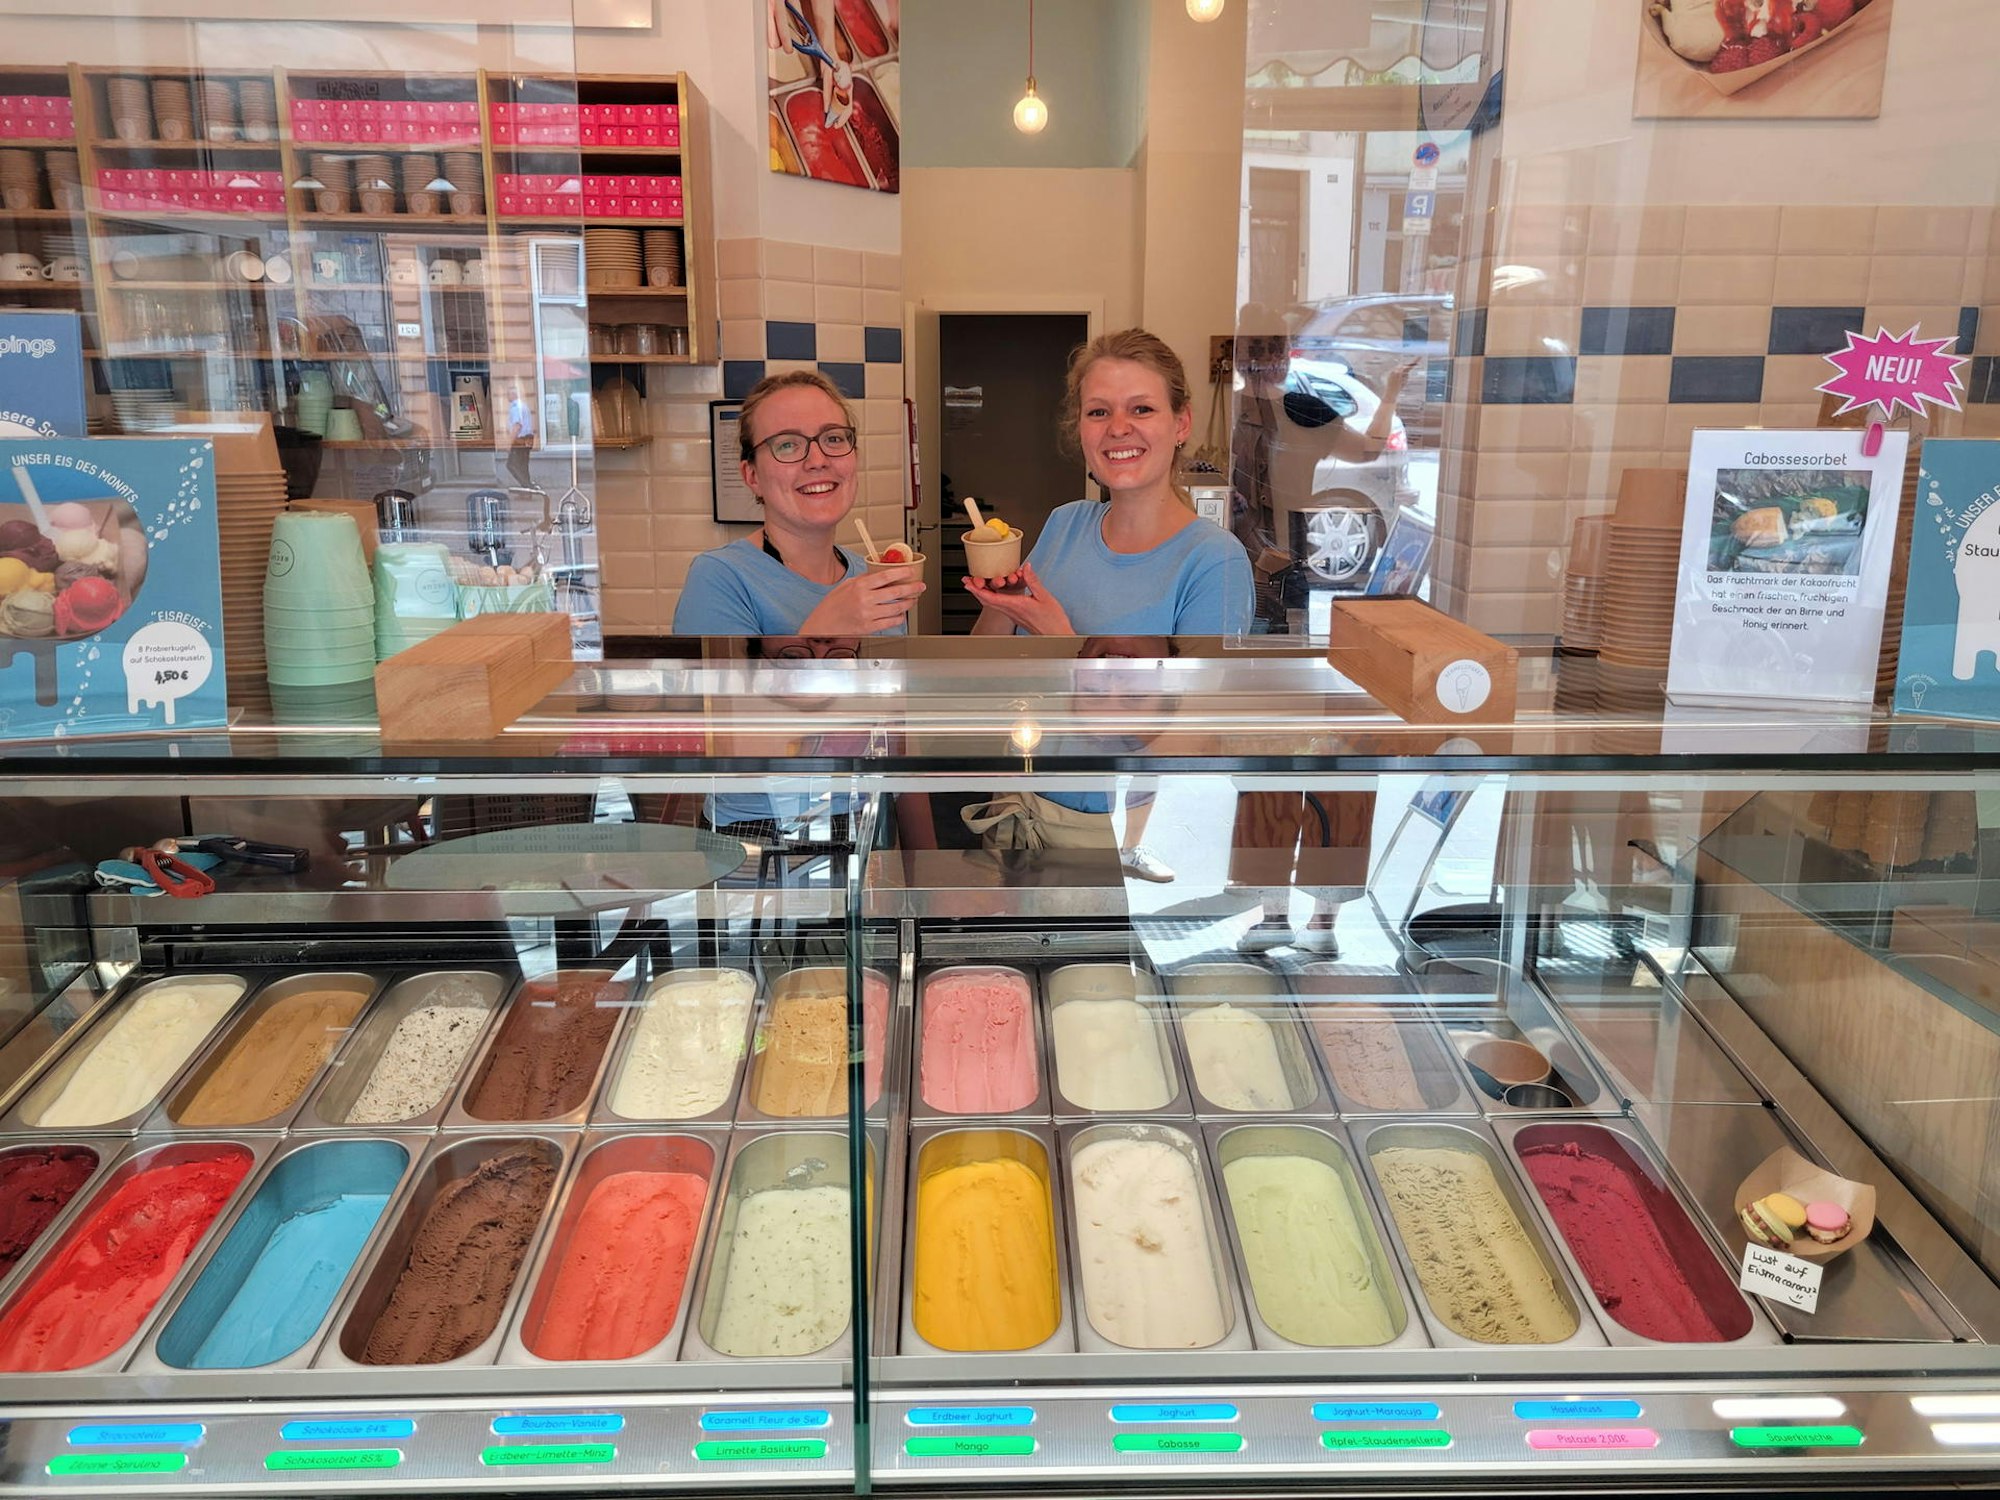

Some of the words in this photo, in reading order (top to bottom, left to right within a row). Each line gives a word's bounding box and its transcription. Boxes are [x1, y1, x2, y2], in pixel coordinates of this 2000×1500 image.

[1865, 355, 1922, 384] NEU!
[0, 410, 35, 427] sere
[11, 453, 51, 467] UNSER
[55, 455, 73, 468] EIS
[75, 459, 97, 475] DES
[1744, 452, 1847, 466] Cabossesorbet
[1955, 492, 1995, 528] UNSER
[1707, 575, 1723, 584] Das
[1726, 575, 1779, 586] Fruchtmark
[1782, 577, 1797, 586] der
[1800, 577, 1857, 588] Kakaofrucht
[1711, 590, 1727, 599] hat
[1757, 591, 1798, 602] frischen,
[1800, 593, 1849, 604] fruchtigen
[1712, 603, 1764, 614] Geschmack
[1767, 606, 1782, 615] der
[1785, 608, 1797, 616] an
[1800, 607, 1824, 616] Birne
[1826, 608, 1845, 617] und
[1742, 619, 1768, 630] Honig
[1771, 621, 1809, 631] erinnert.
[145, 644, 196, 653] Probierkugeln
[1753, 1250, 1778, 1266] Lust
[1784, 1263, 1809, 1279] auf
[1158, 1408, 1196, 1419] Joghurt
[1333, 1407, 1422, 1417] Joghurt-Maracuja
[1551, 1405, 1603, 1414] Haselnuss
[708, 1415, 755, 1425] Karamell
[758, 1415, 785, 1425] Fleur
[787, 1415, 801, 1424] de
[803, 1415, 820, 1424] Sel
[932, 1411, 970, 1421] Erdbeer
[974, 1411, 1013, 1423] Joghurt
[302, 1425, 363, 1435] Schokolade
[521, 1419, 608, 1429] Bourbon-Vanille
[1556, 1434, 1598, 1443] Pistazie
[1766, 1432, 1834, 1442] Sauerkirsche
[716, 1446, 757, 1456] Limette
[760, 1444, 811, 1454] Basilikum
[954, 1442, 990, 1453] Mango
[1157, 1439, 1200, 1449] Cabosse
[284, 1455, 358, 1466] Schokosorbet
[361, 1453, 385, 1464] 85%
[489, 1449, 607, 1461] Erdbeer-Limette-Minz
